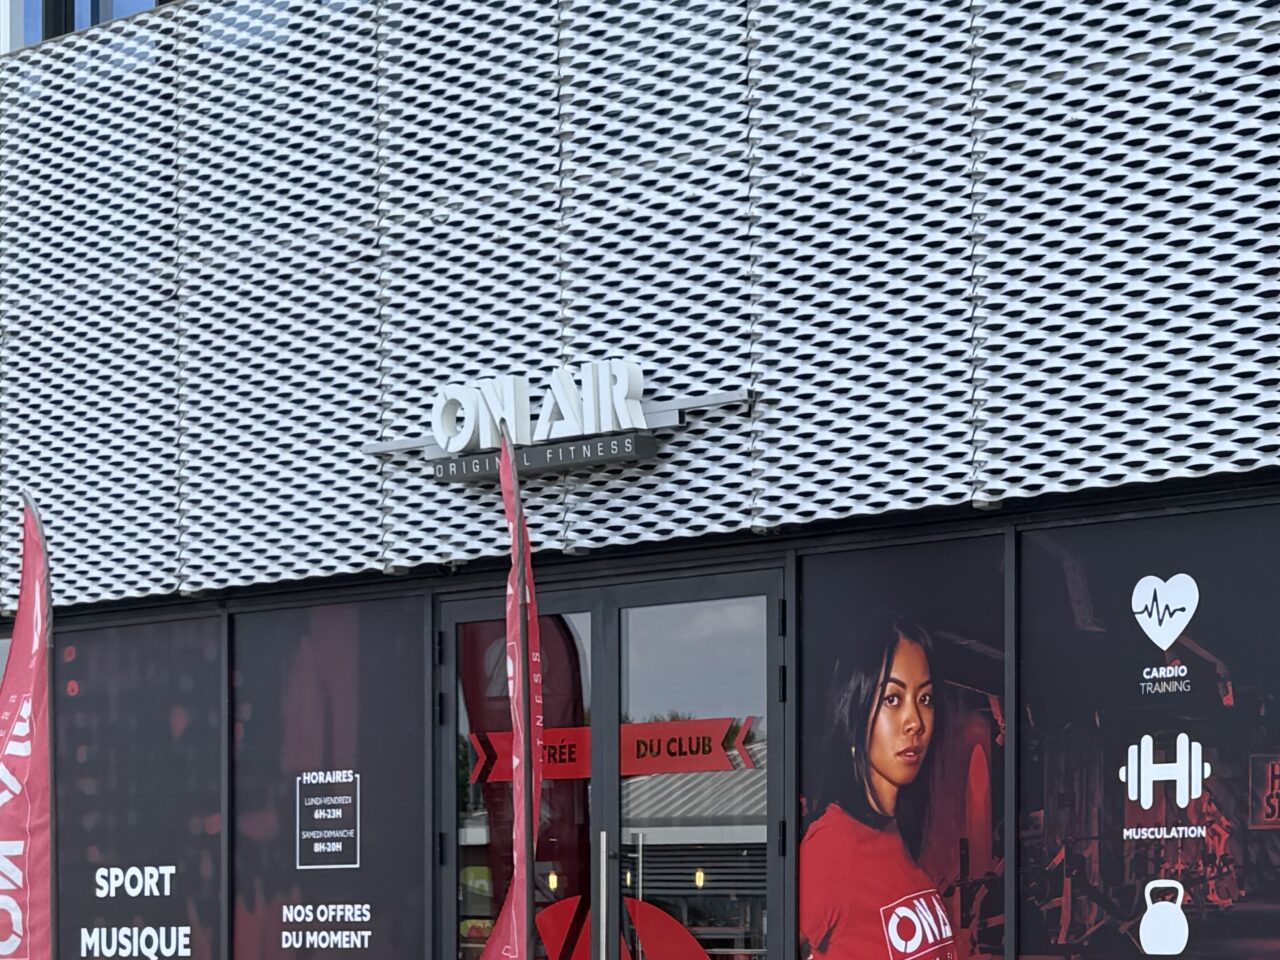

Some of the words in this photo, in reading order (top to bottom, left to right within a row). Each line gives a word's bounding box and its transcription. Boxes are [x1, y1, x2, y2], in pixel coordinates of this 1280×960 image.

[436, 454, 530, 477] ORIGINL
[547, 438, 632, 463] FITNESS
[1143, 665, 1188, 679] CARDIO
[1140, 680, 1191, 695] TRAINING
[543, 739, 577, 764] RÉE
[636, 739, 660, 759] DU
[666, 736, 712, 758] CLUB
[303, 770, 354, 784] HORAIRES
[1123, 826, 1207, 840] MUSCULATION
[95, 866, 176, 898] SPORT
[282, 905, 313, 922] NOS
[317, 904, 371, 922] OFFRES
[281, 931, 303, 949] DU
[306, 931, 372, 949] MOMENT
